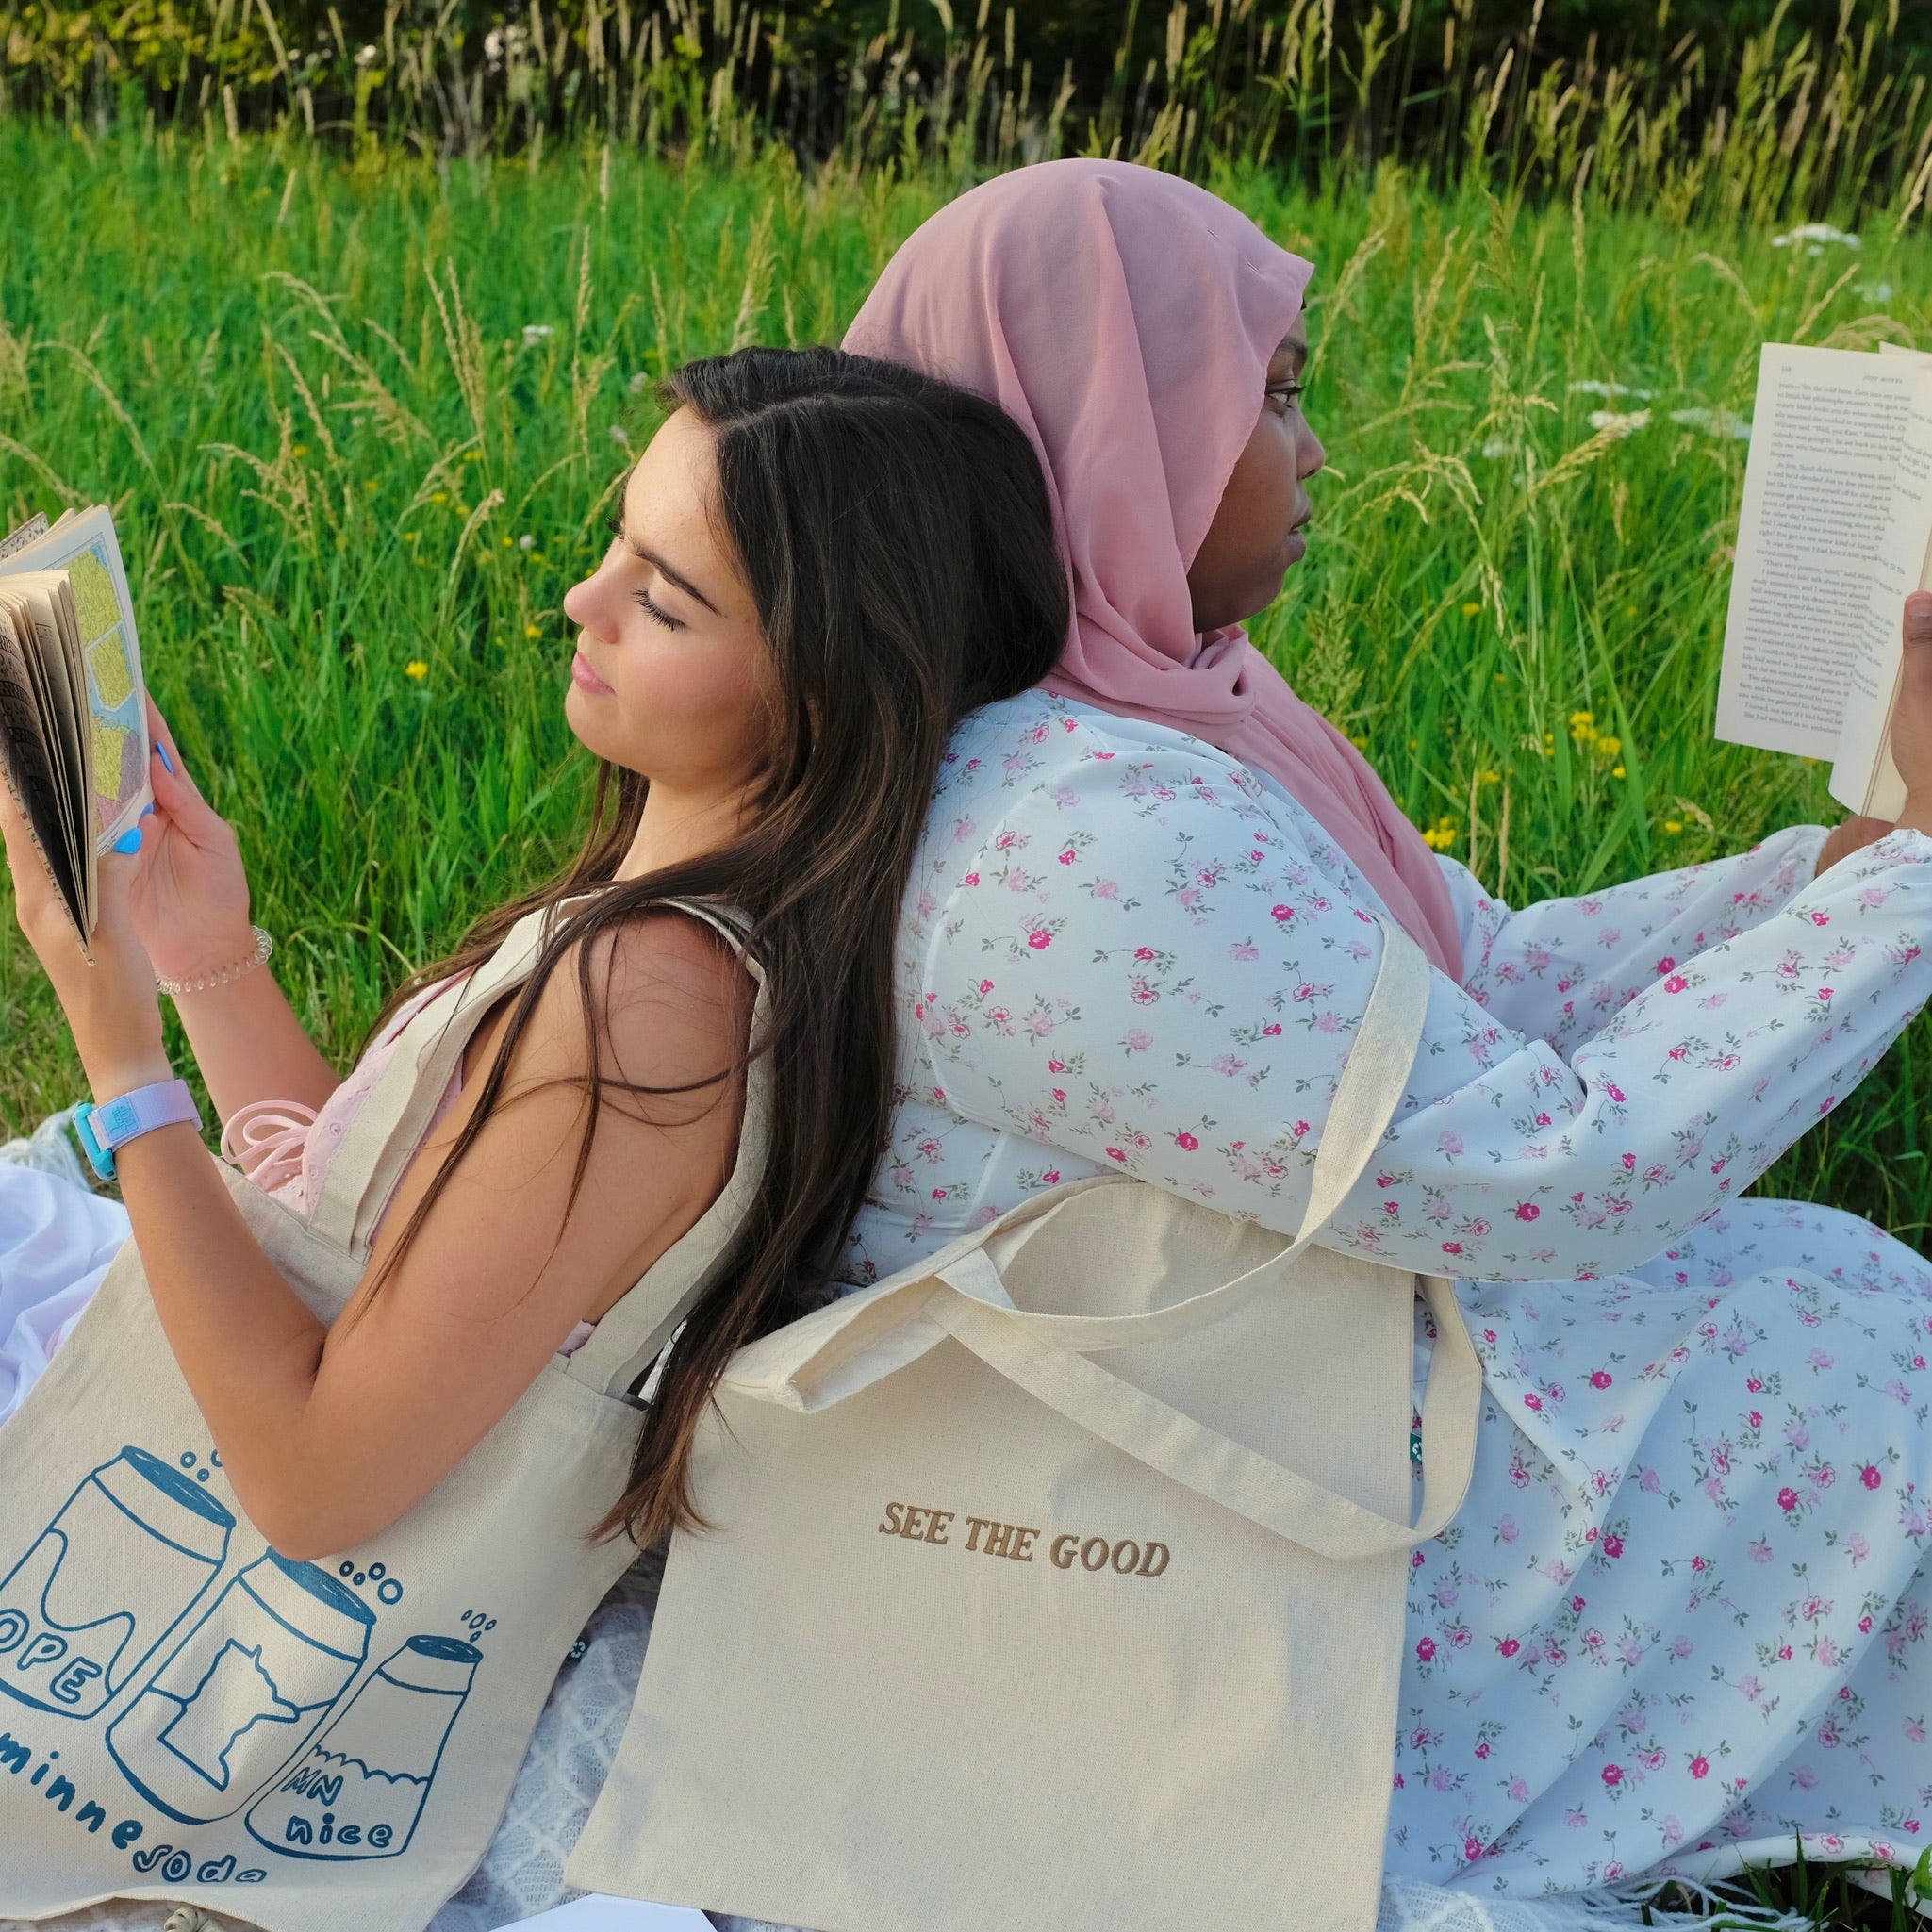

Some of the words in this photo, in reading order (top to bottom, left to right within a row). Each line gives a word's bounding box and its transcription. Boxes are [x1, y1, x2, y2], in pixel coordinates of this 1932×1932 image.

[879, 1501, 955, 1545] SEE
[965, 1516, 1041, 1562] THE
[1049, 1533, 1170, 1577] GOOD
[280, 1766, 344, 1807] MN
[285, 1812, 393, 1849] nice
